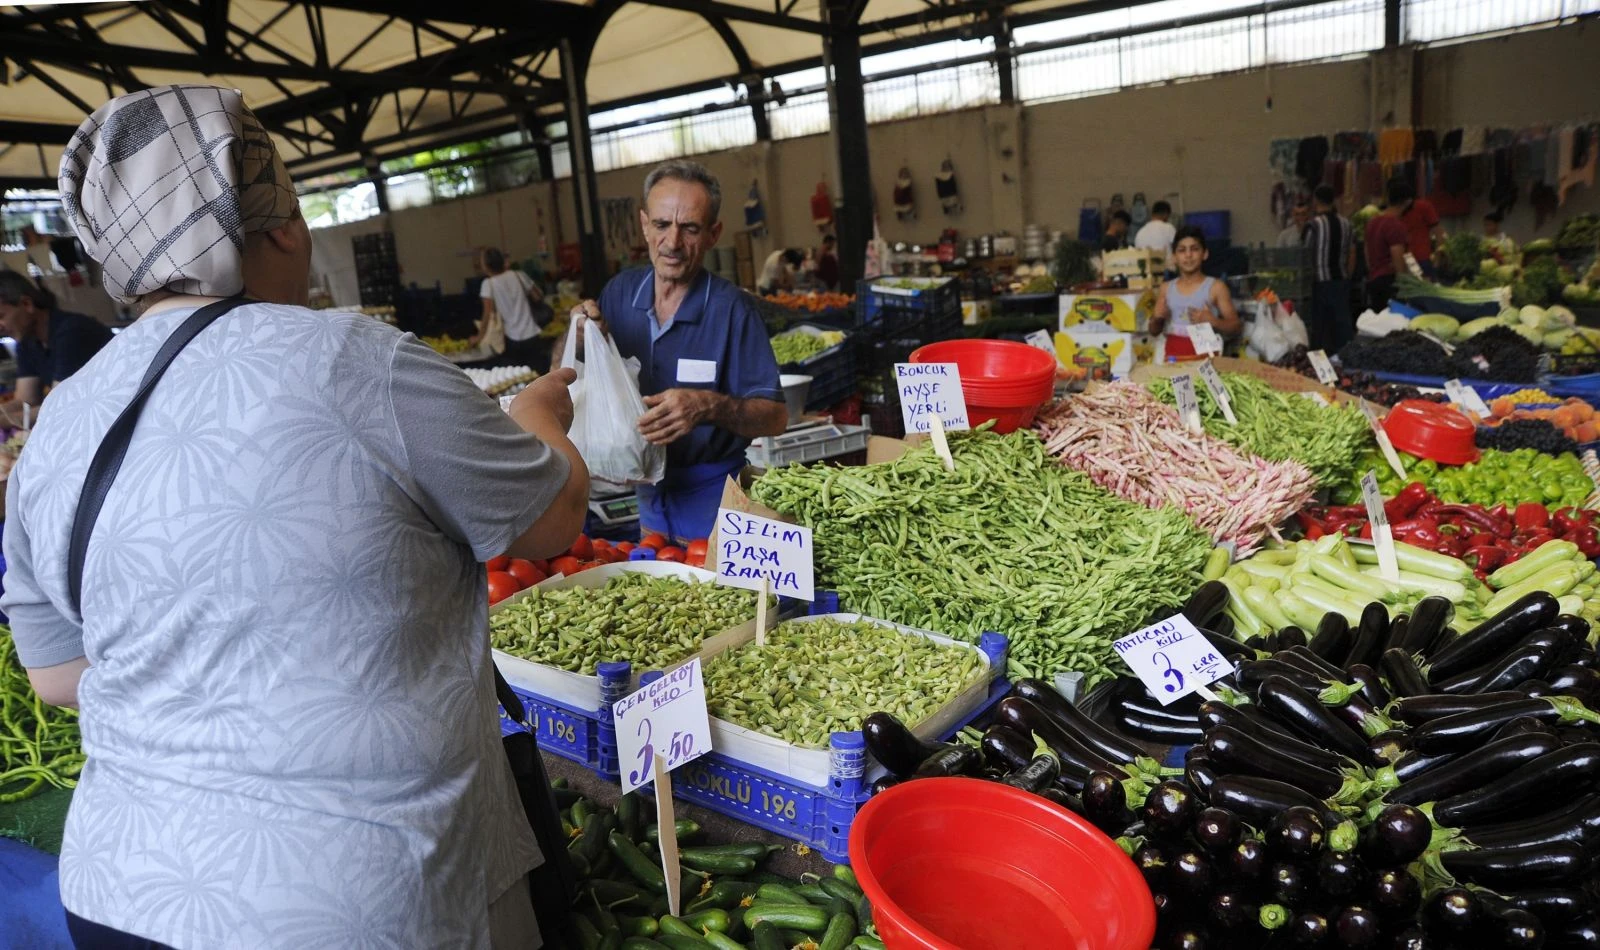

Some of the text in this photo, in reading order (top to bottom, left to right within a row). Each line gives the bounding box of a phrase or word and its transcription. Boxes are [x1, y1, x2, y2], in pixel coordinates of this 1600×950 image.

[897, 365, 948, 377] BONCUK
[1152, 651, 1184, 693] 3
[547, 717, 576, 743] 196
[761, 790, 796, 820] 196
